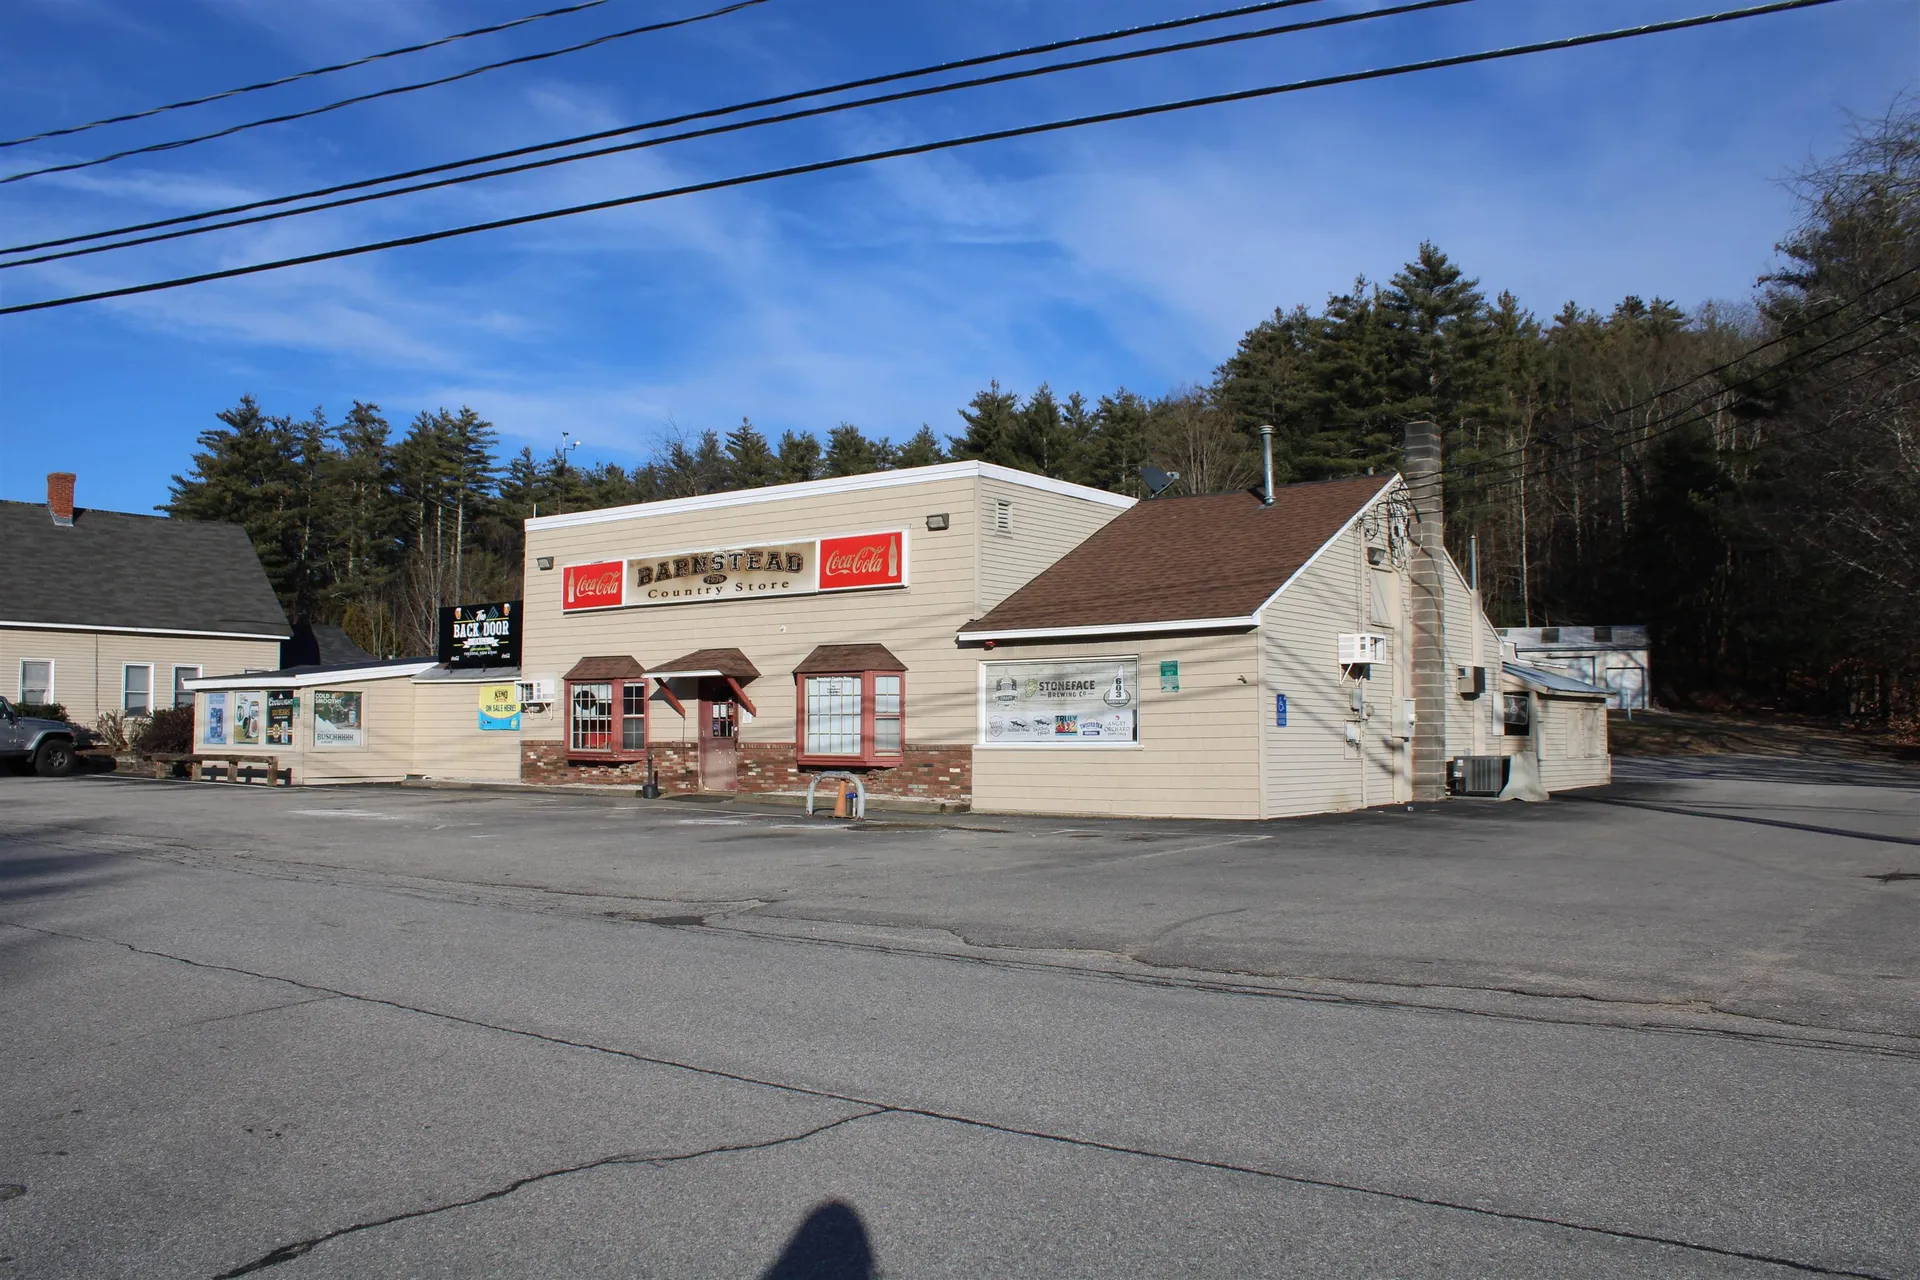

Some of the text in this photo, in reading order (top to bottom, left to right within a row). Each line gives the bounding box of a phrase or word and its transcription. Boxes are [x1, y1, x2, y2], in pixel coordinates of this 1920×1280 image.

[637, 550, 803, 587] BARNSTEAD
[648, 581, 790, 599] Country Store
[453, 620, 510, 638] BACK DOOR
[1039, 680, 1095, 691] STONEFACE
[494, 689, 509, 700] KENO
[493, 704, 504, 712] SALE
[504, 704, 517, 712] HERE!
[1055, 715, 1078, 723] TRULY
